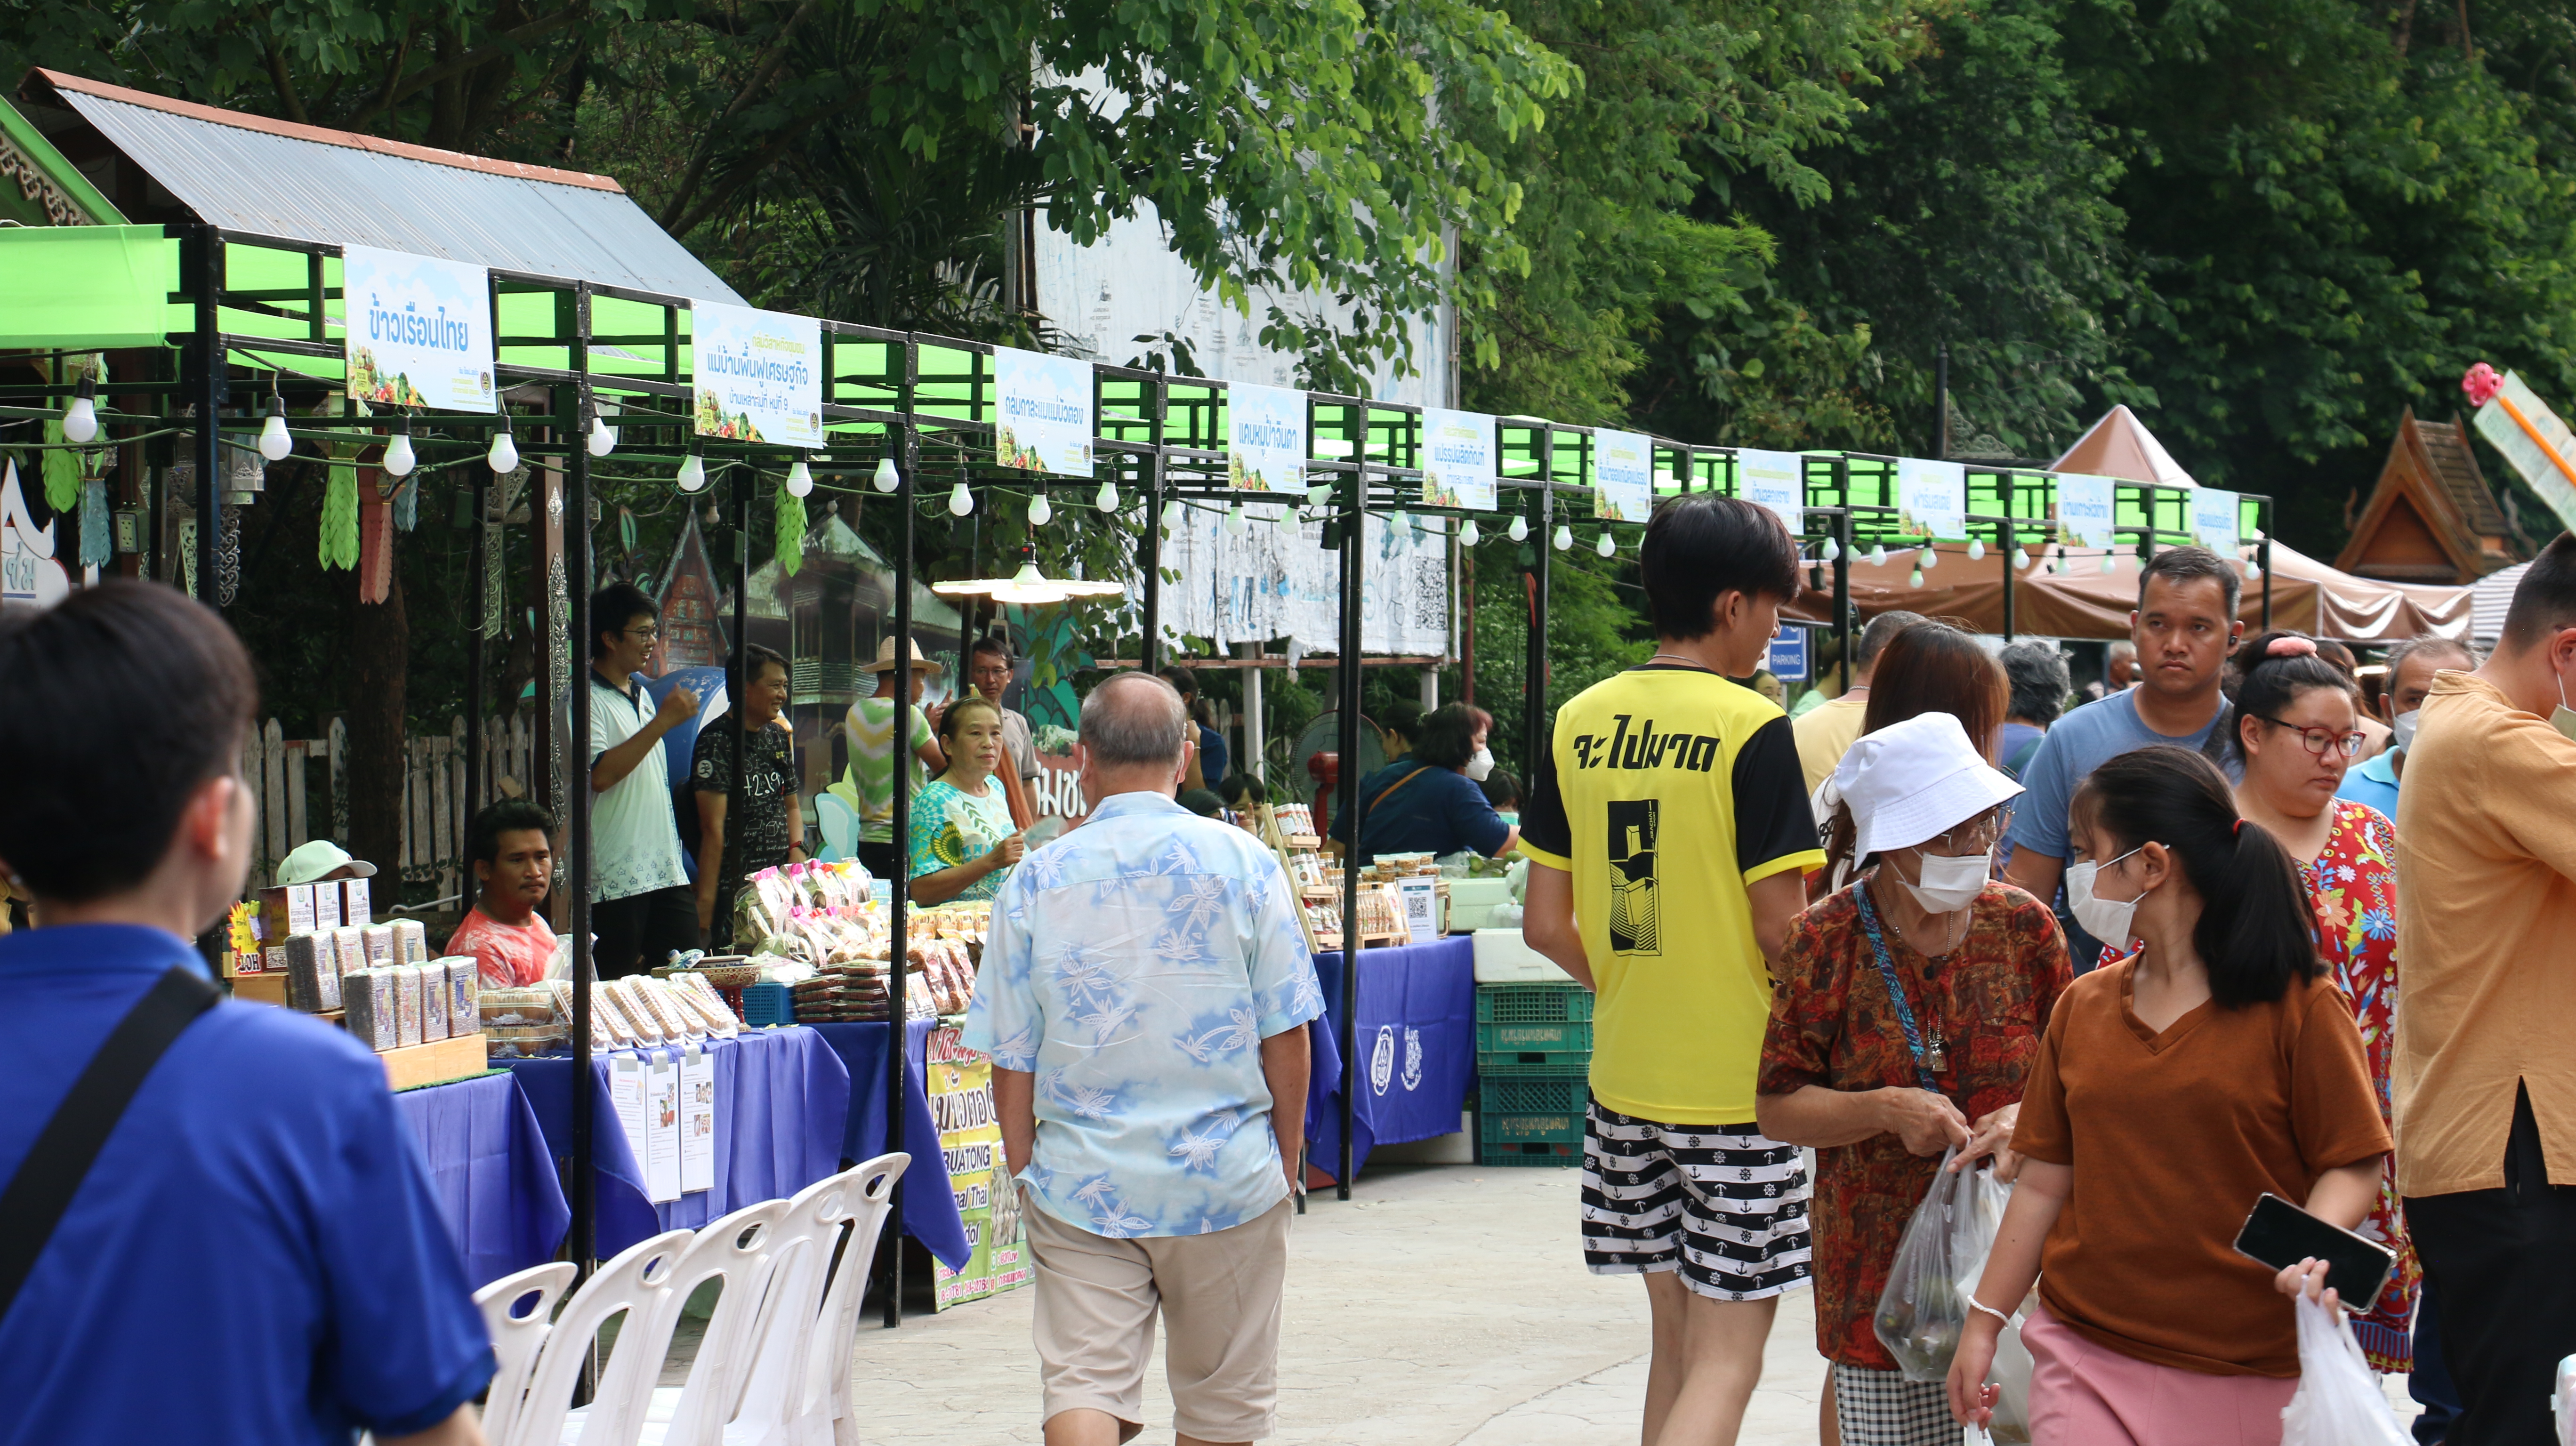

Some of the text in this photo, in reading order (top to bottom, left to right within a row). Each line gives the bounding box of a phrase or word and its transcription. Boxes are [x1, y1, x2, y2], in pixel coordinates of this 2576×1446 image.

[370, 292, 468, 352] ข้าวเรือนไทย
[708, 341, 808, 391] แม่บ้านฟื้นฟูเศรษฐกิจ
[784, 398, 788, 411] 9
[1005, 388, 1084, 425] กลุ่มกาละแมแม่บัวตอง
[1239, 414, 1297, 457] แคบหมูป้าจินดา
[1435, 443, 1485, 470] แปรรูปผลิตภัณฑ์
[1772, 655, 1801, 665] PARKING
[943, 1145, 990, 1173] BUATONG
[971, 1184, 987, 1207] Thai
